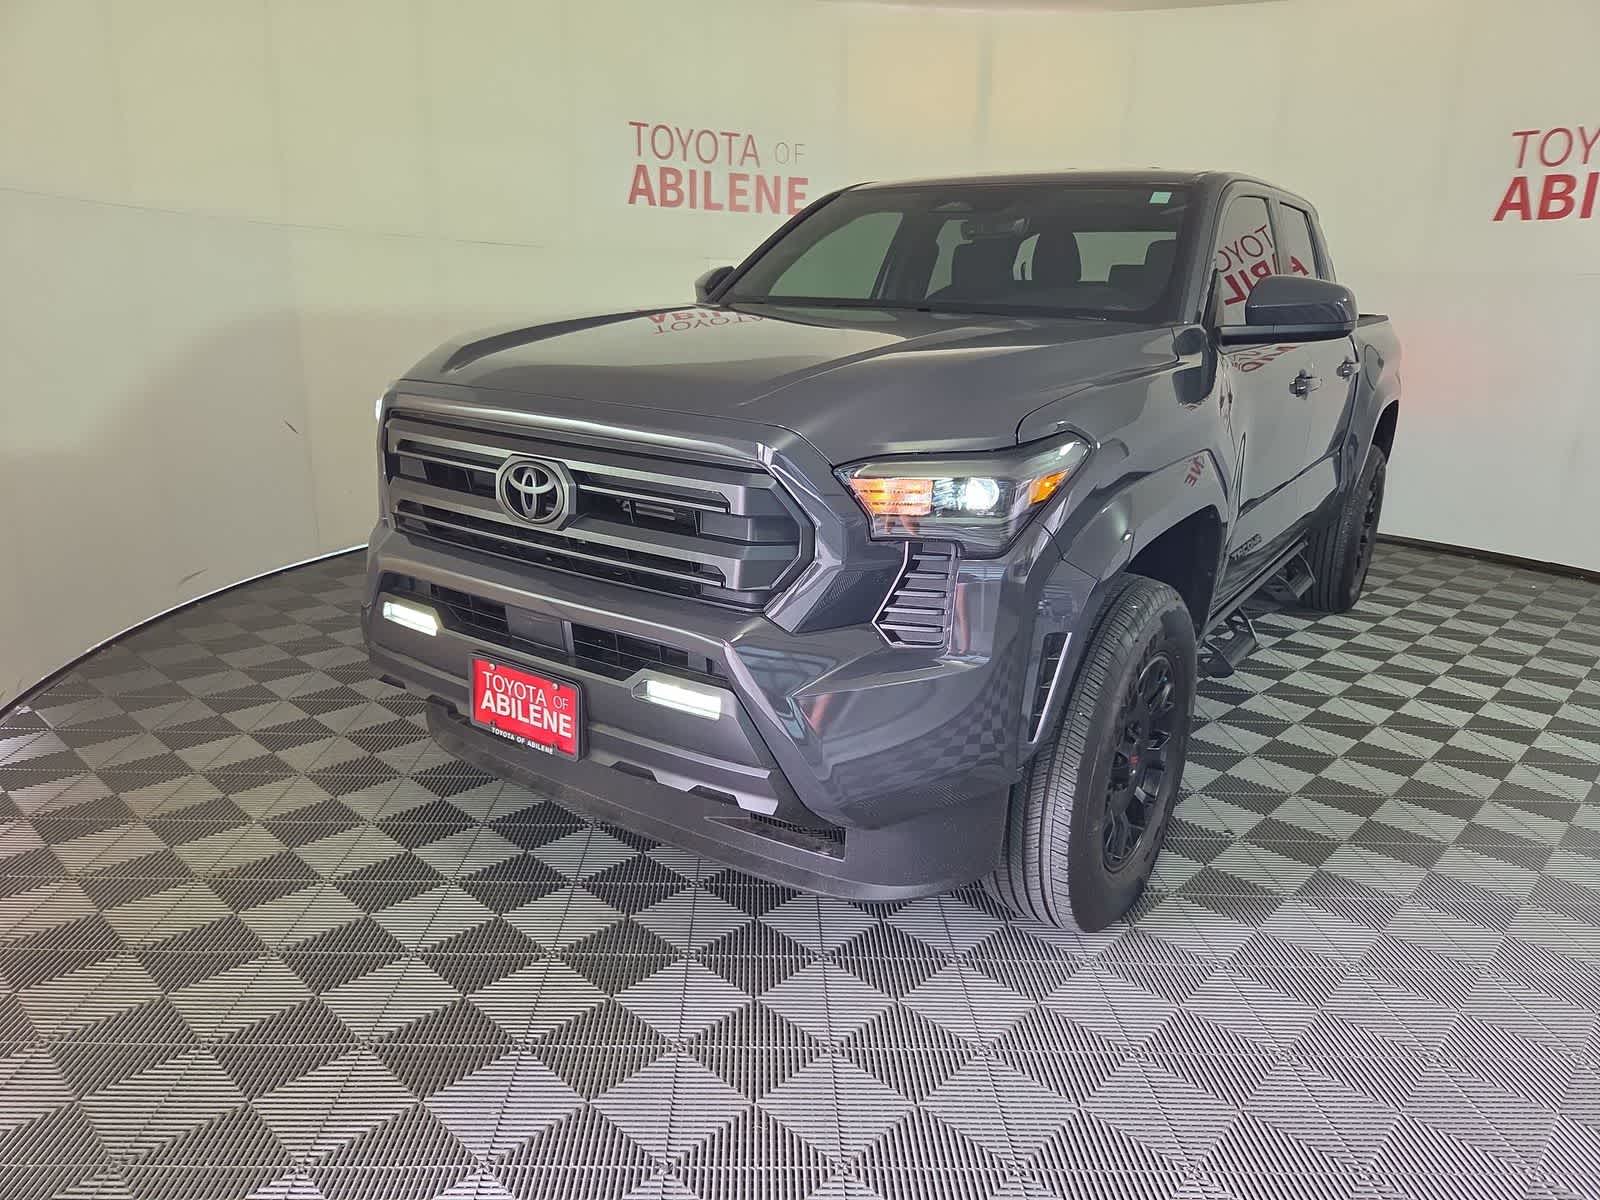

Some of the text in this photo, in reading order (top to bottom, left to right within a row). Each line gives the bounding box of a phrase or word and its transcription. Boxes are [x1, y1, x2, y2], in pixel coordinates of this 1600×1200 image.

[628, 121, 805, 168] TOYOTA OF
[1512, 126, 1600, 169] TOY
[627, 164, 809, 216] ABILENE
[482, 671, 569, 710] TOYOTA OF
[480, 689, 573, 738] ABILENE
[491, 727, 553, 755] TOYOTA OF ABILENE
